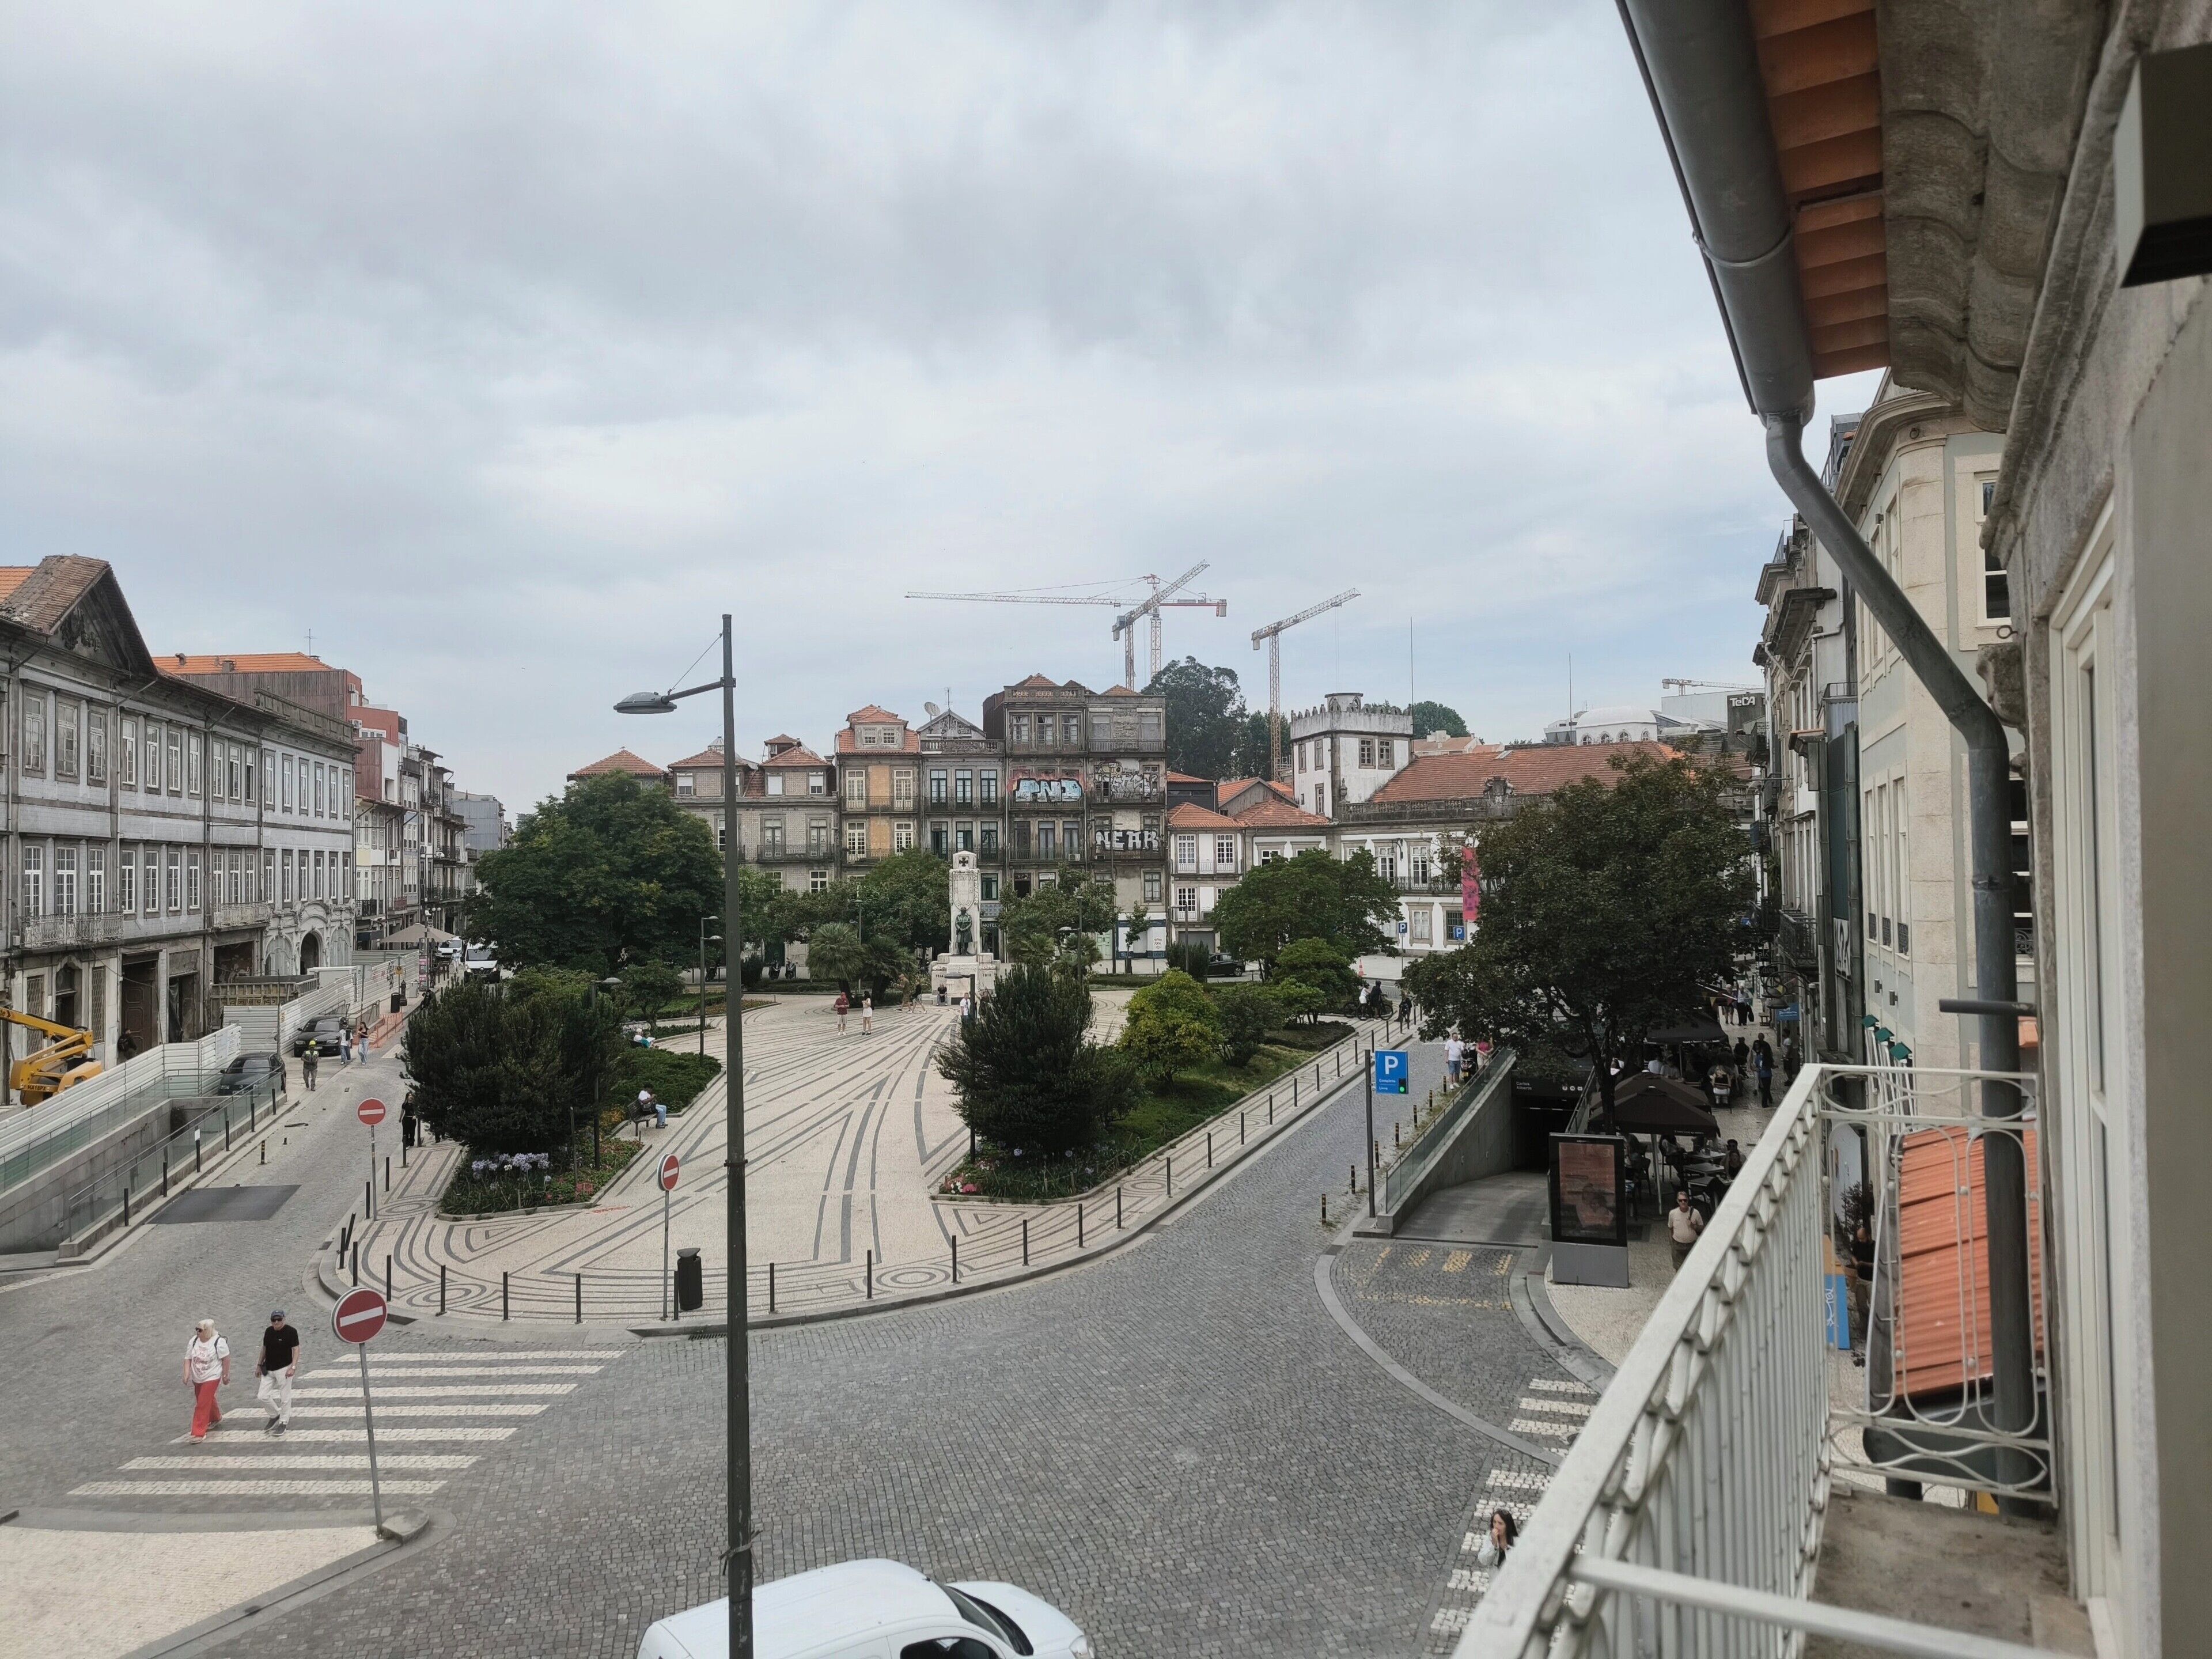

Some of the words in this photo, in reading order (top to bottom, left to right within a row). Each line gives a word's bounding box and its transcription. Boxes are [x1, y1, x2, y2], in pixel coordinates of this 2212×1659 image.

[1730, 696, 1755, 707] TeCA
[1095, 830, 1160, 851] NEAR
[1400, 923, 1406, 933] P
[1456, 927, 1462, 937] P
[1385, 1055, 1399, 1075] P
